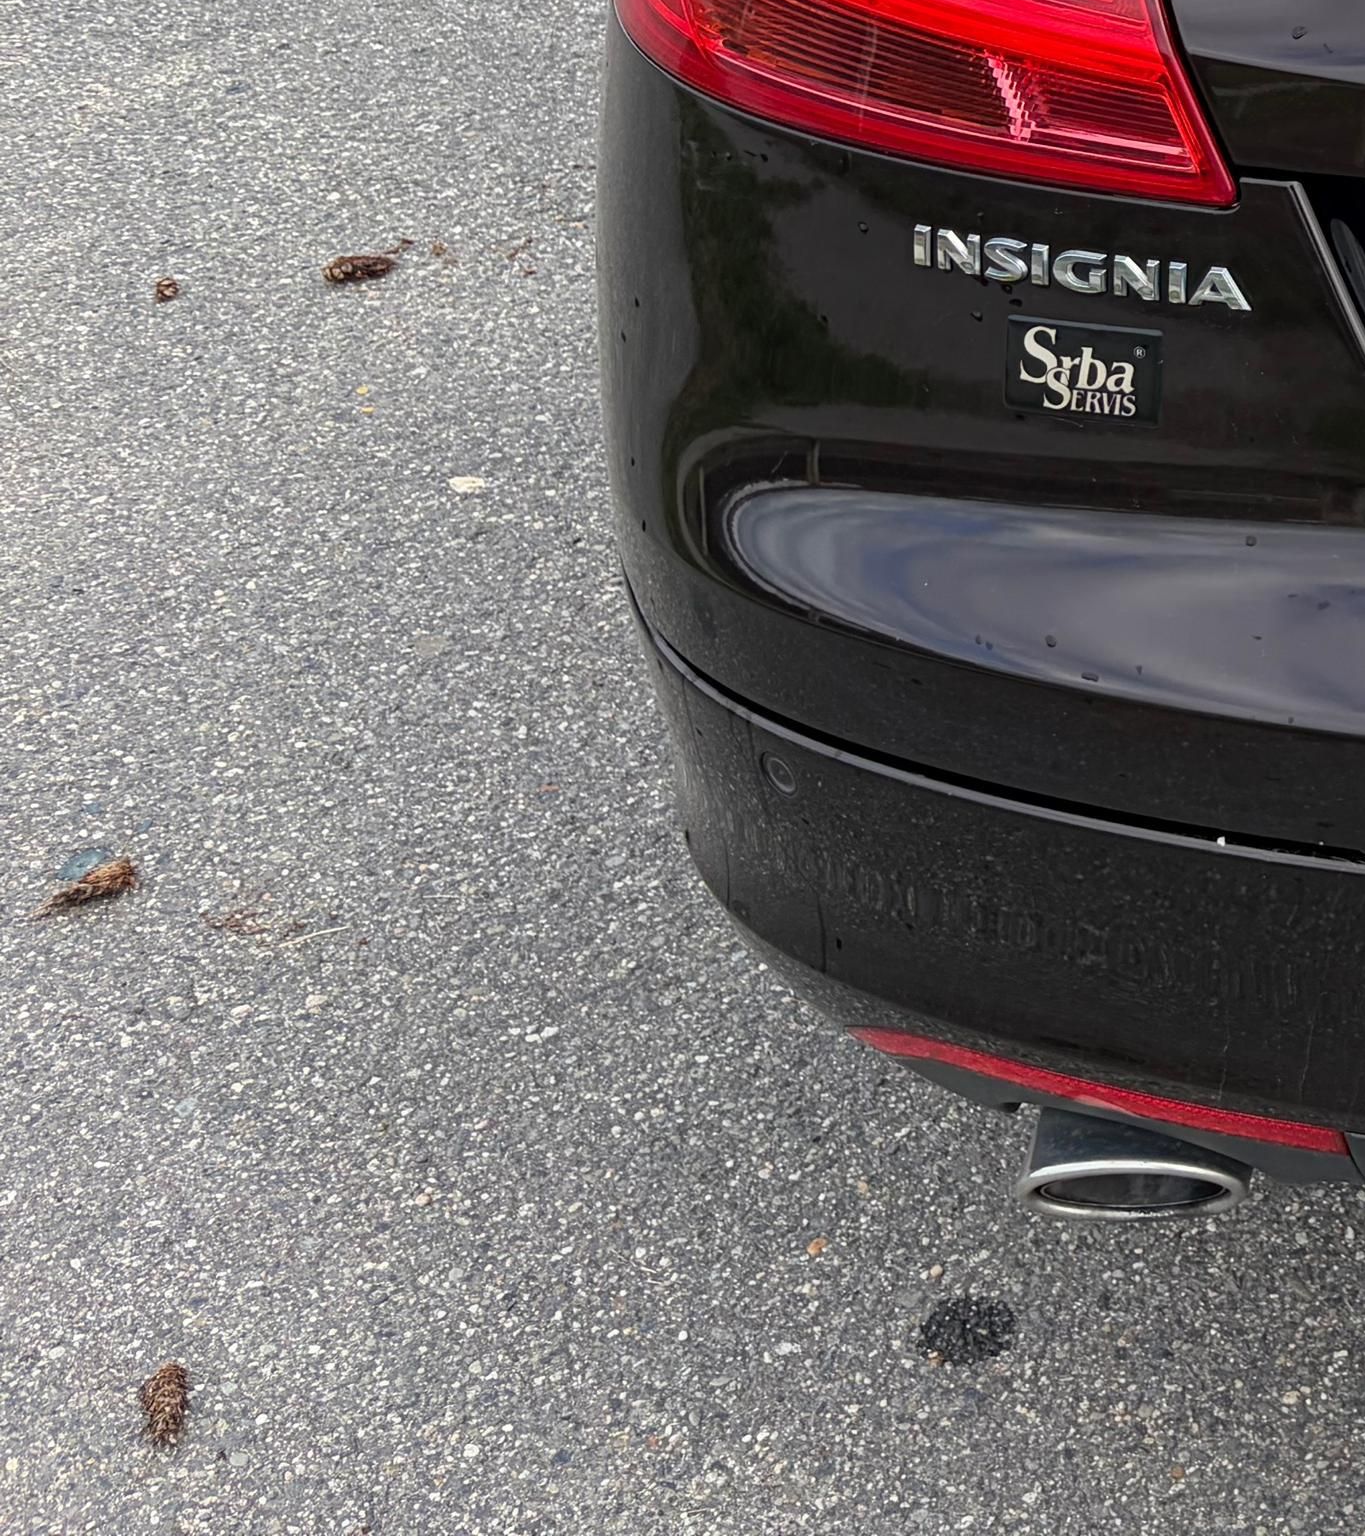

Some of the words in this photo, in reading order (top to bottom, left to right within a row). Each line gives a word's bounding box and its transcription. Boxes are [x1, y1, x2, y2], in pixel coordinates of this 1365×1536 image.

[913, 223, 1252, 311] INSIGNIA
[1019, 325, 1135, 394] Srba
[1042, 366, 1137, 417] SERVIS
